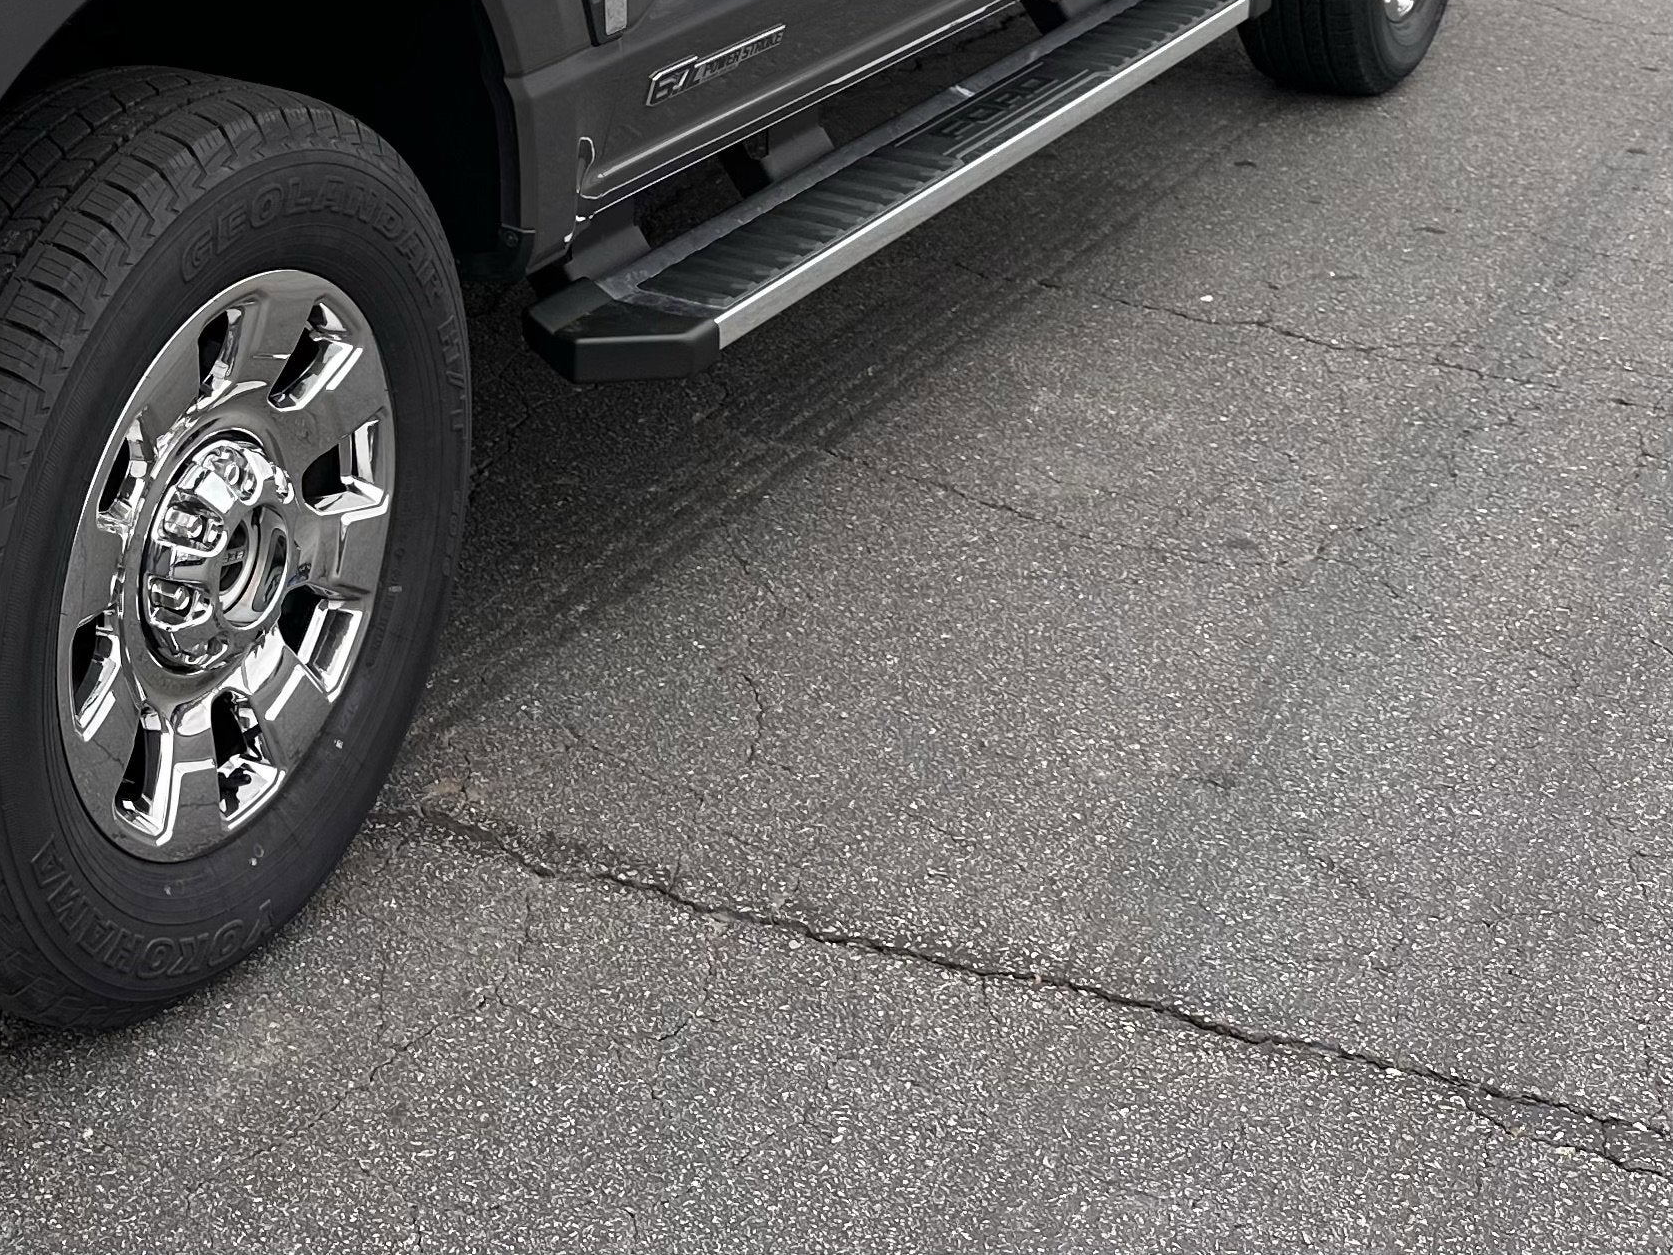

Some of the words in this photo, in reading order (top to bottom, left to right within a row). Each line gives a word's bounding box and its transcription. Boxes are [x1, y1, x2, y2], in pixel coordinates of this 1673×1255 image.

[930, 76, 1059, 140] FORD
[180, 175, 444, 309] GEOLANDAR
[29, 831, 277, 982] YOKOHAMA
